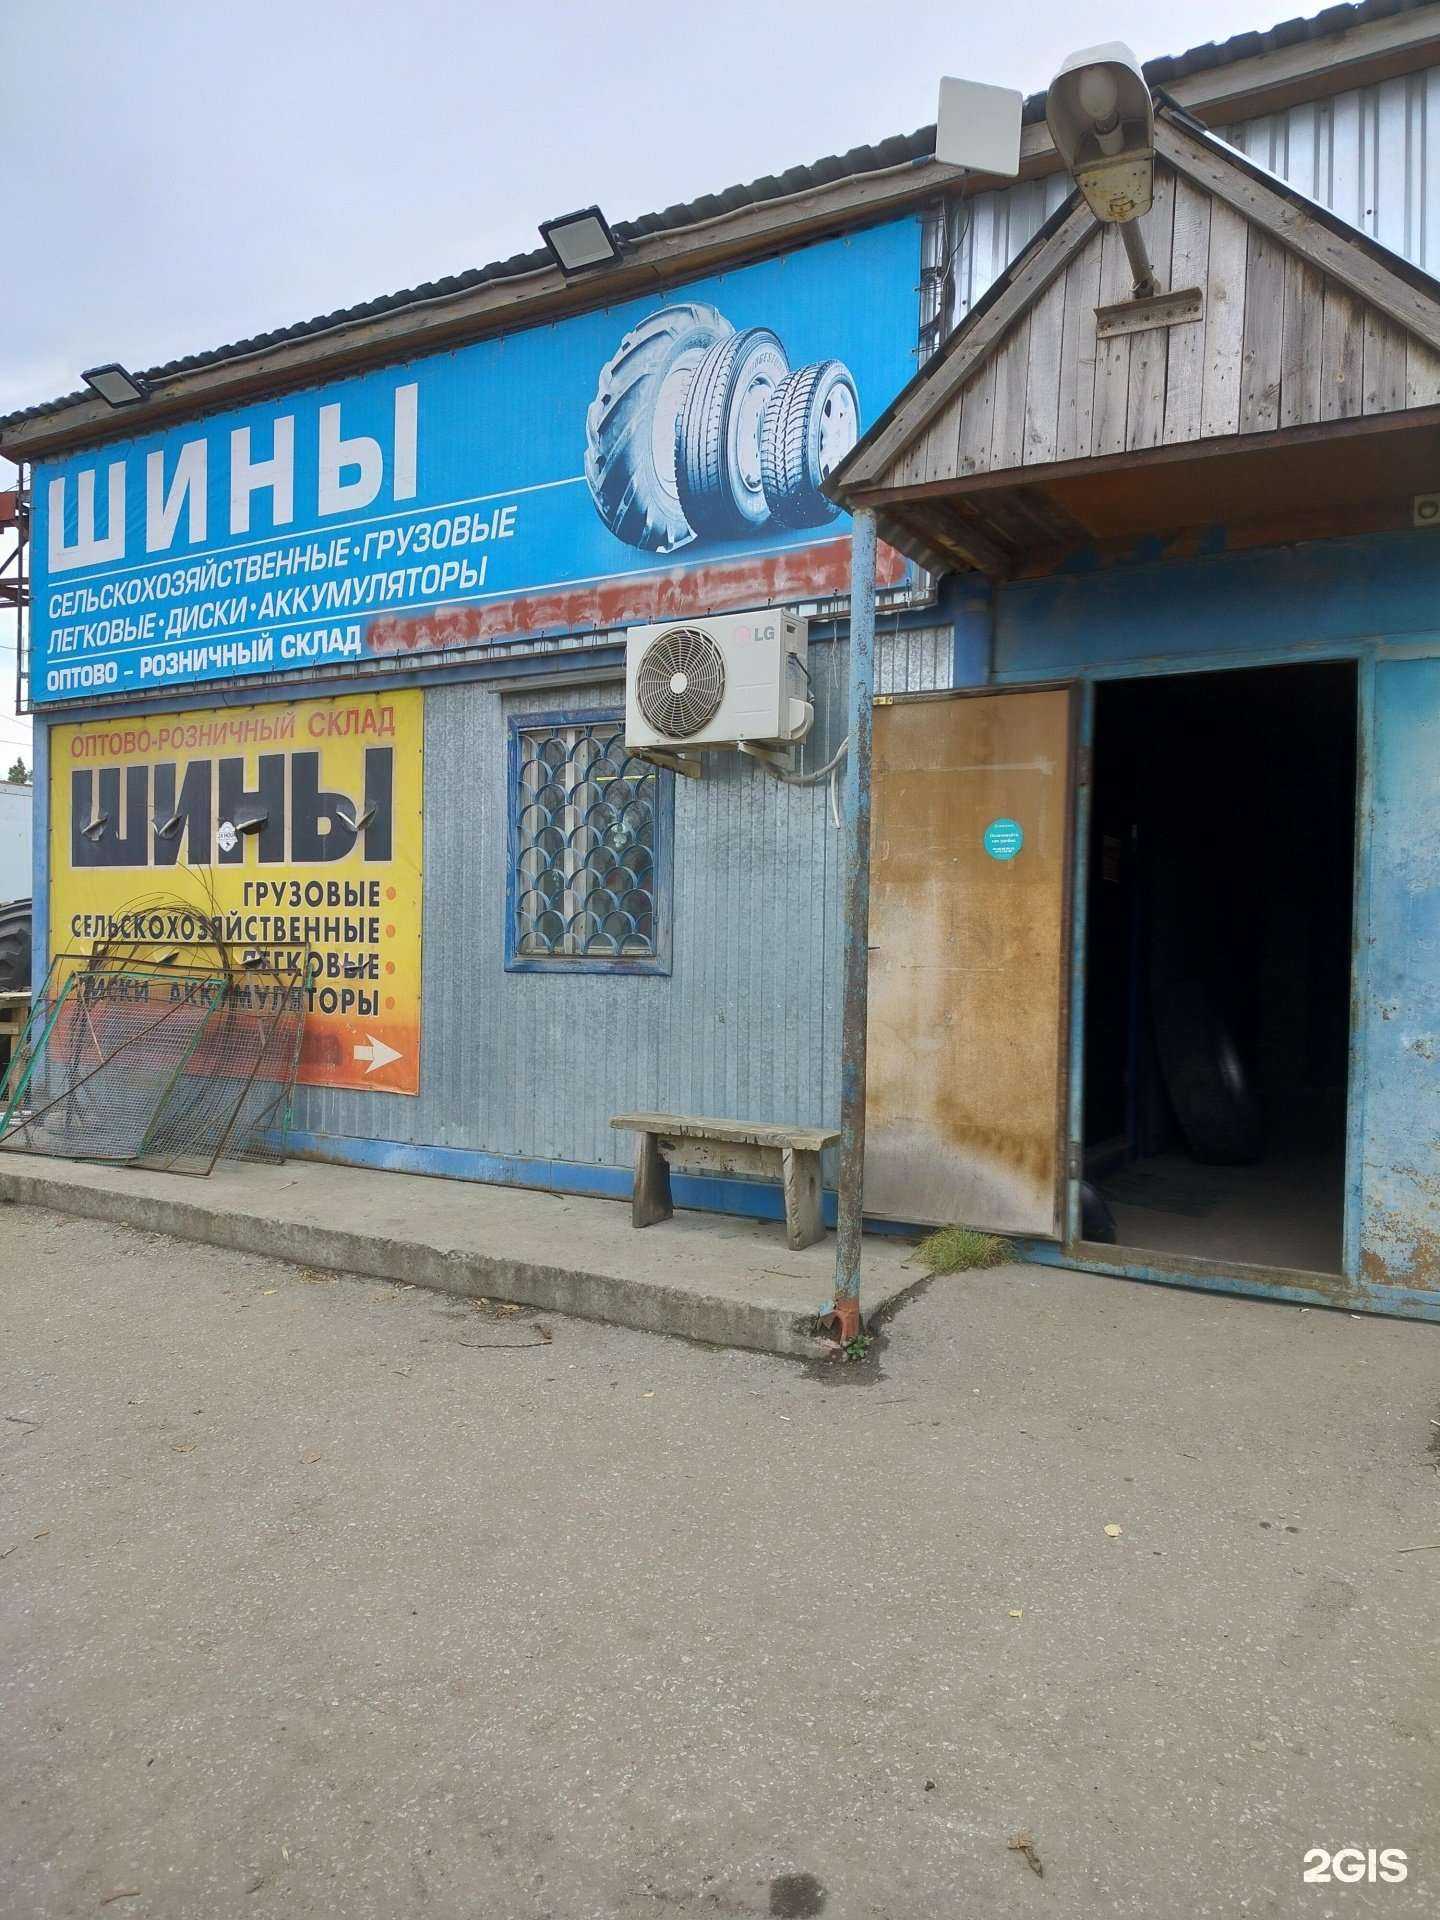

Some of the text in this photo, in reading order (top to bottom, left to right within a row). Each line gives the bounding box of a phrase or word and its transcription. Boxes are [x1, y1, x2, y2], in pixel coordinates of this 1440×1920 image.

[48, 383, 418, 574] ШИНЫ
[47, 661, 118, 691] ОПТОВО
[140, 633, 273, 679] РОЗНИЧНЫЙ
[281, 625, 361, 659] СКЛАД
[754, 625, 775, 641] LG
[71, 706, 395, 758] ОПТОВО-РОЗНИЧНЫЙ СКЛАД
[72, 747, 393, 867] ШИНЫ
[243, 881, 380, 907] ГРУЗОВЫЕ
